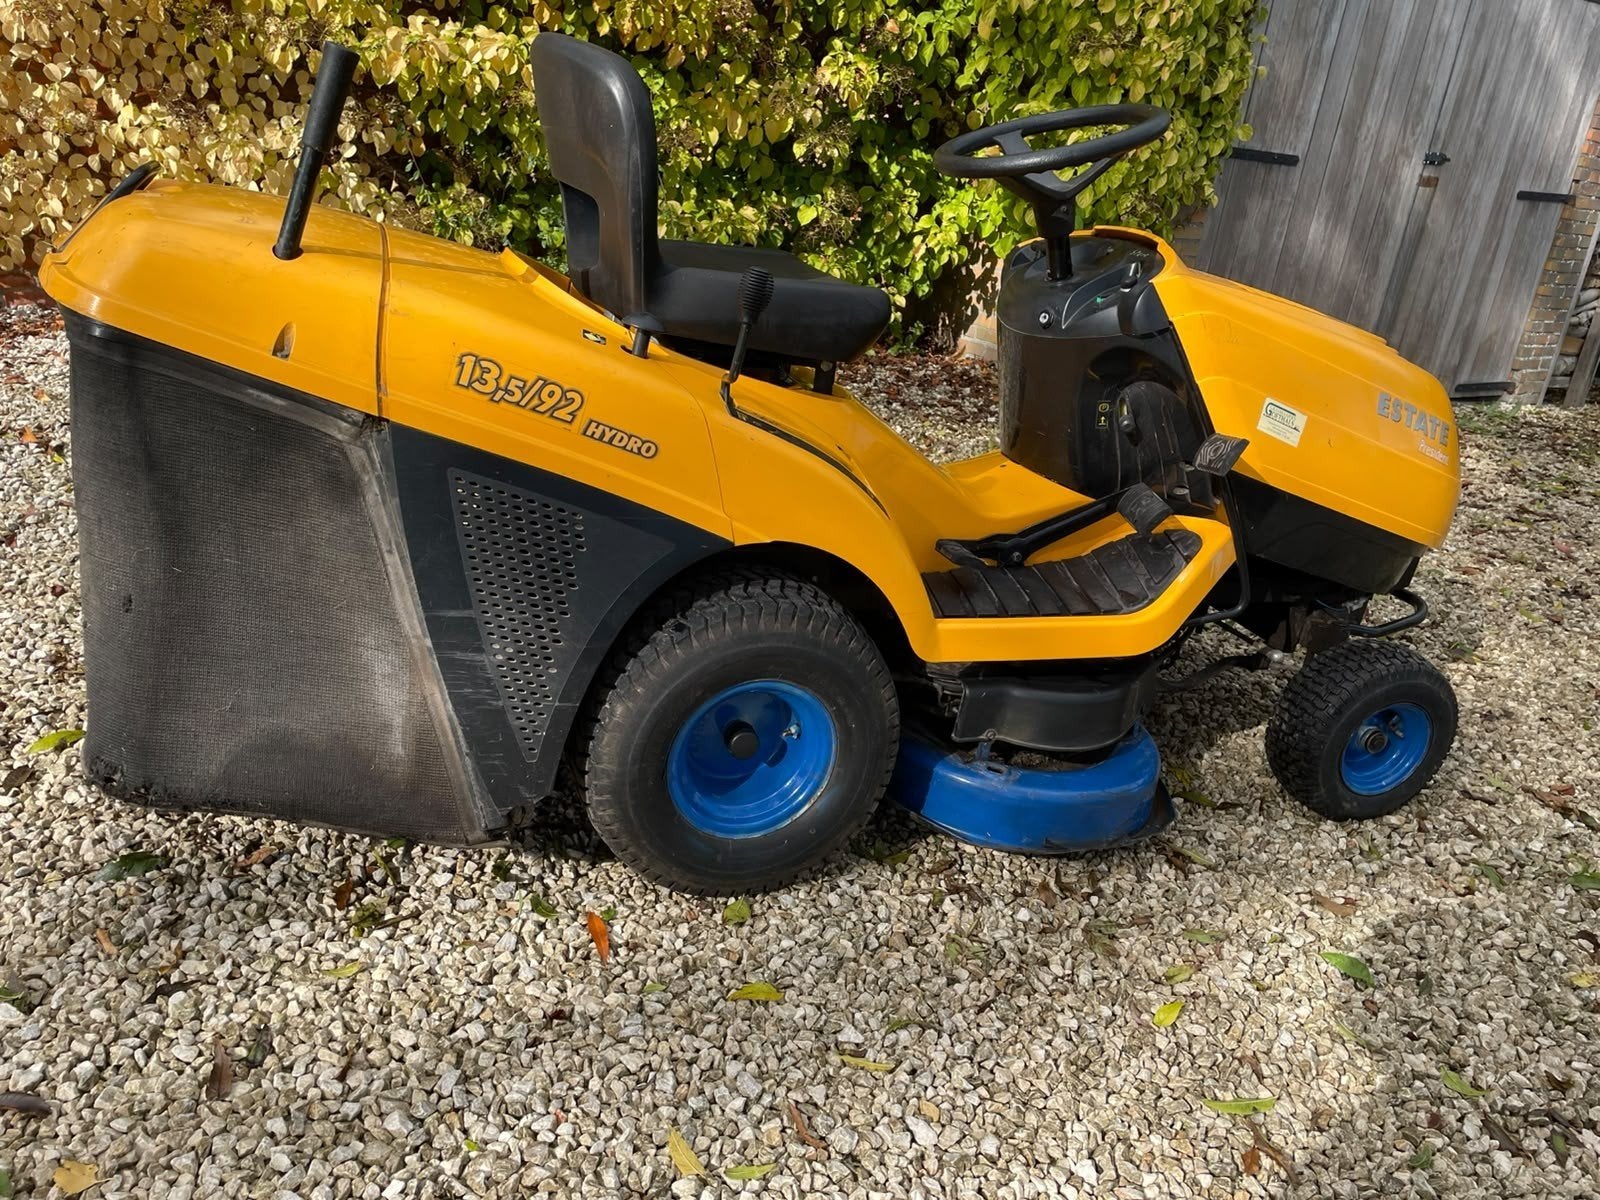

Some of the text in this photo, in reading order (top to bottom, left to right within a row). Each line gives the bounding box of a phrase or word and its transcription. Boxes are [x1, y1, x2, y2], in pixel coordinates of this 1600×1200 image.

[456, 352, 659, 459] 13,5/92 HYDRO
[1377, 391, 1450, 447] ESTATE
